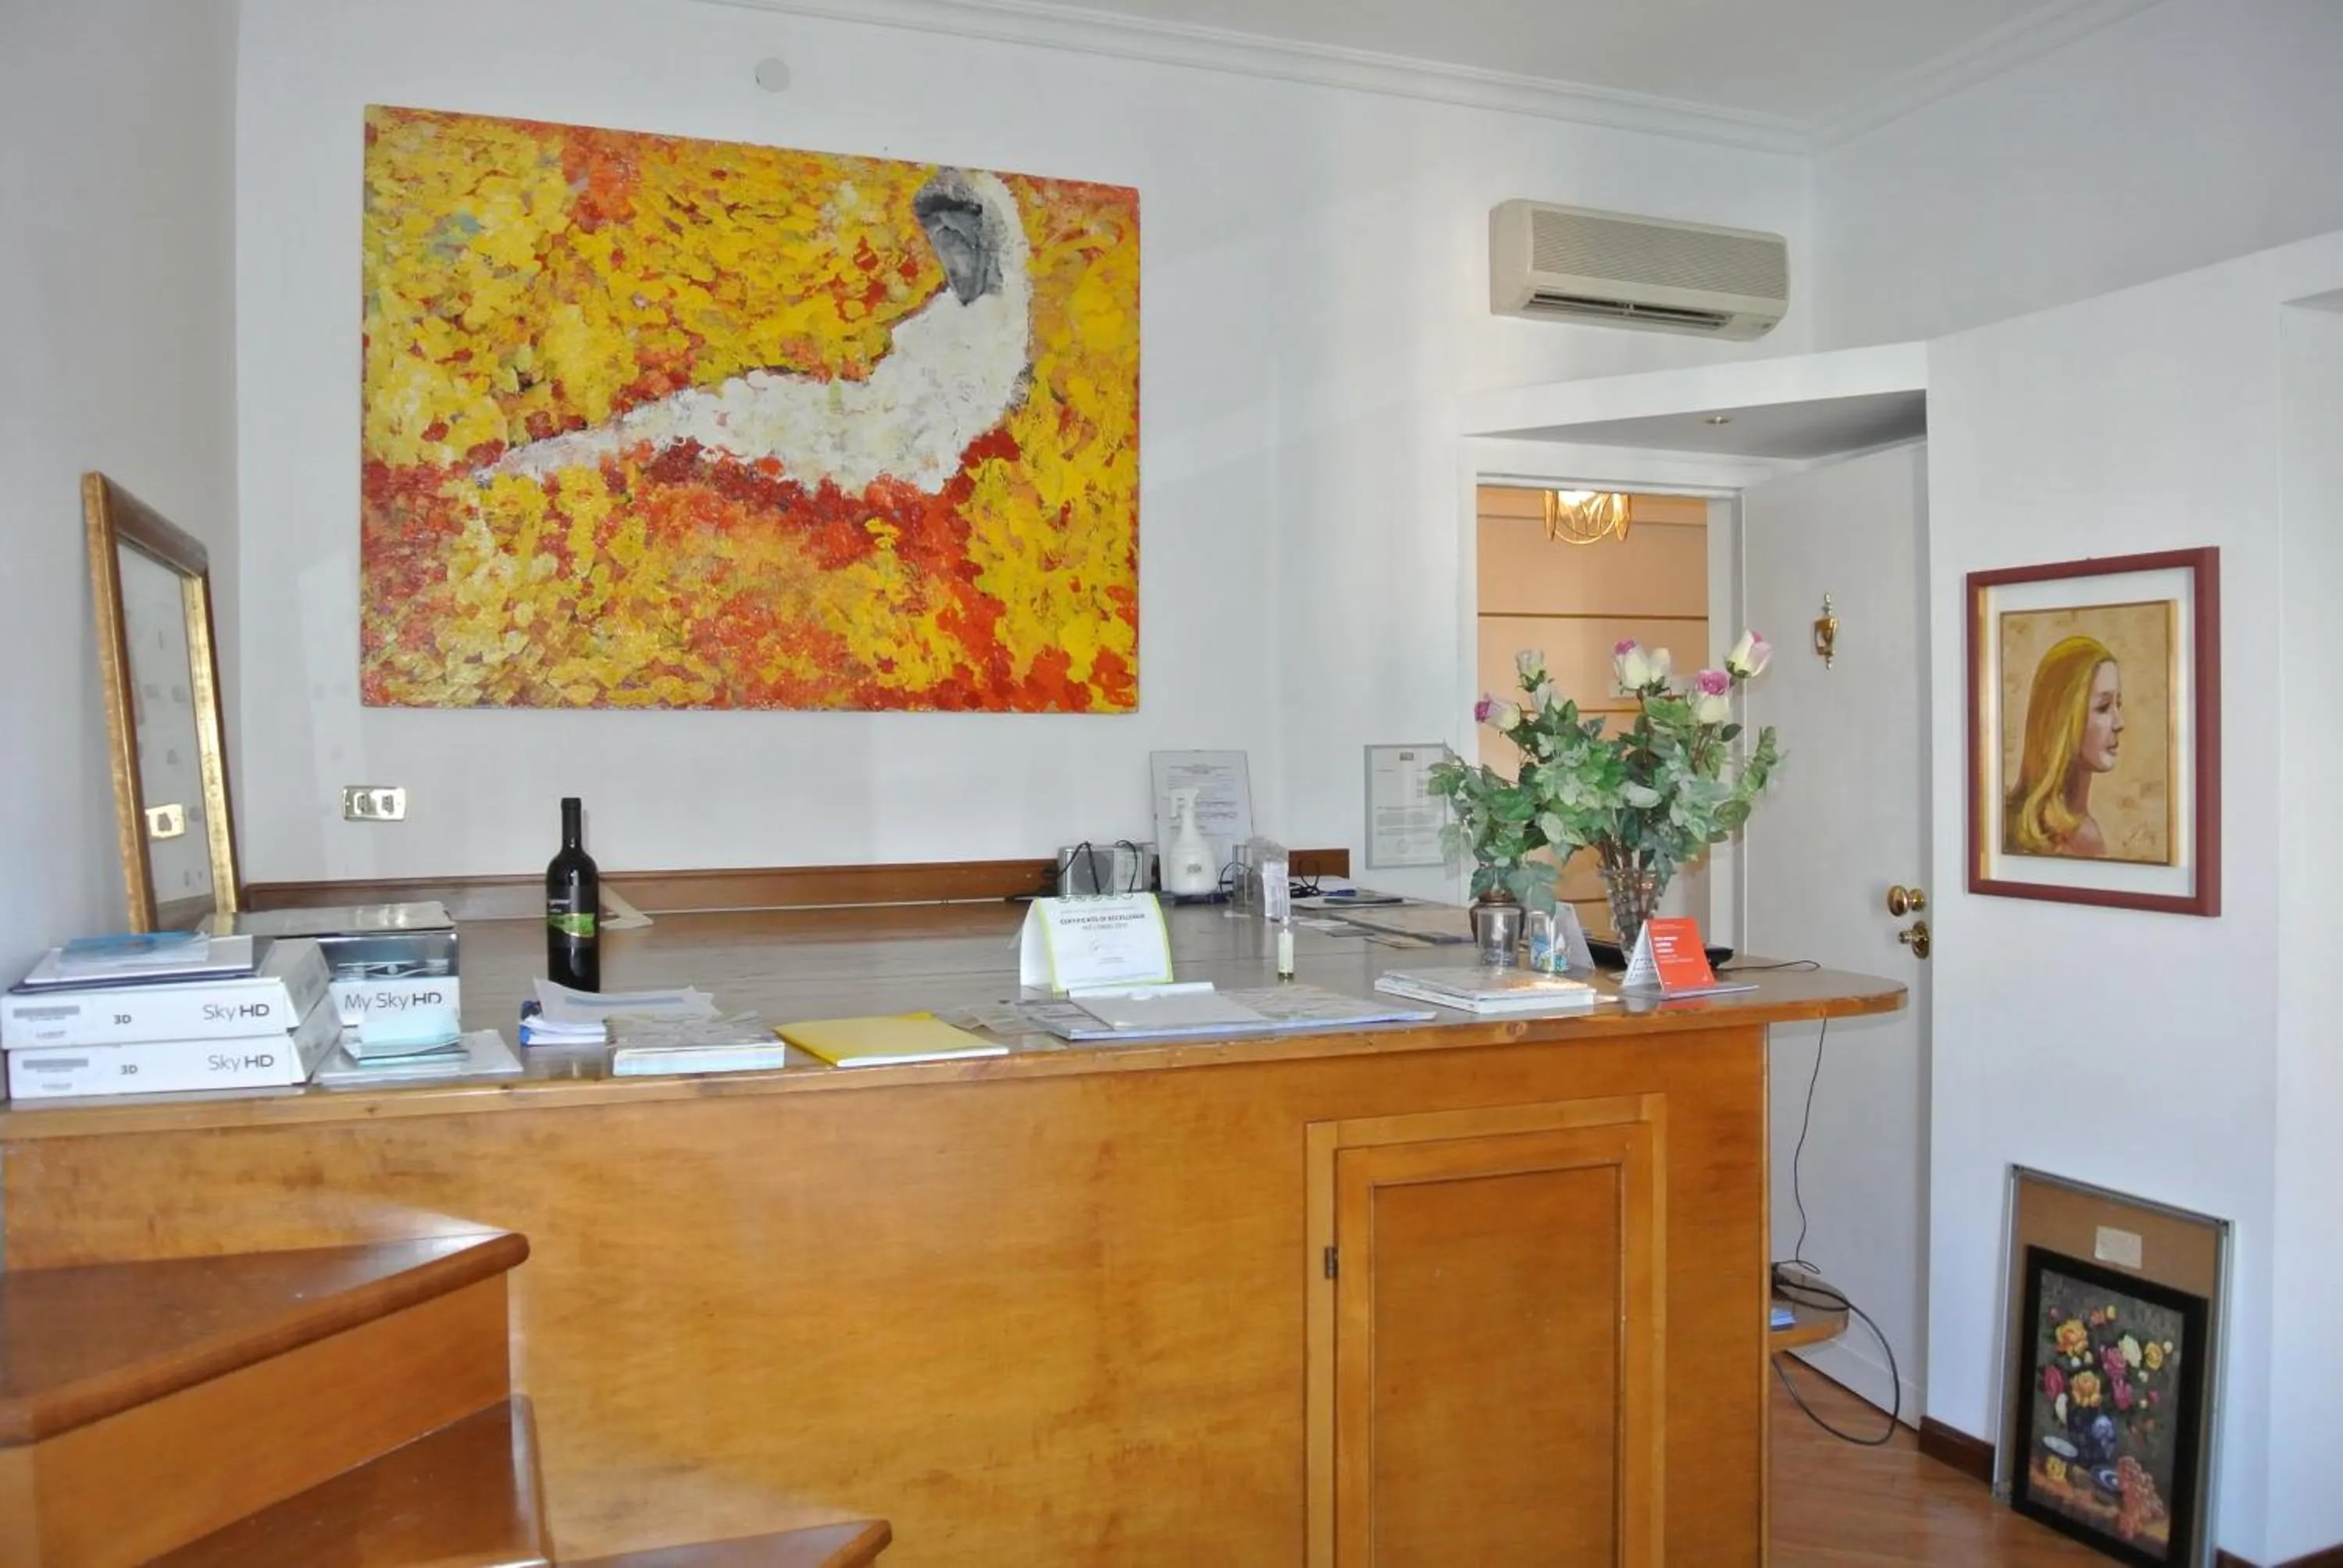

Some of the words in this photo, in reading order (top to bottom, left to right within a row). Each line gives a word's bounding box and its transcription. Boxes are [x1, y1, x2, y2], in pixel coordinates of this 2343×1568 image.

[344, 993, 373, 1012] My
[376, 992, 408, 1011] Sky
[412, 991, 443, 1007] HD
[113, 1014, 132, 1025] 3D
[202, 1003, 237, 1023] Sky
[239, 1003, 270, 1018] HD
[120, 1064, 139, 1075] 3D
[207, 1053, 241, 1073] Sky
[244, 1053, 275, 1070] HD
